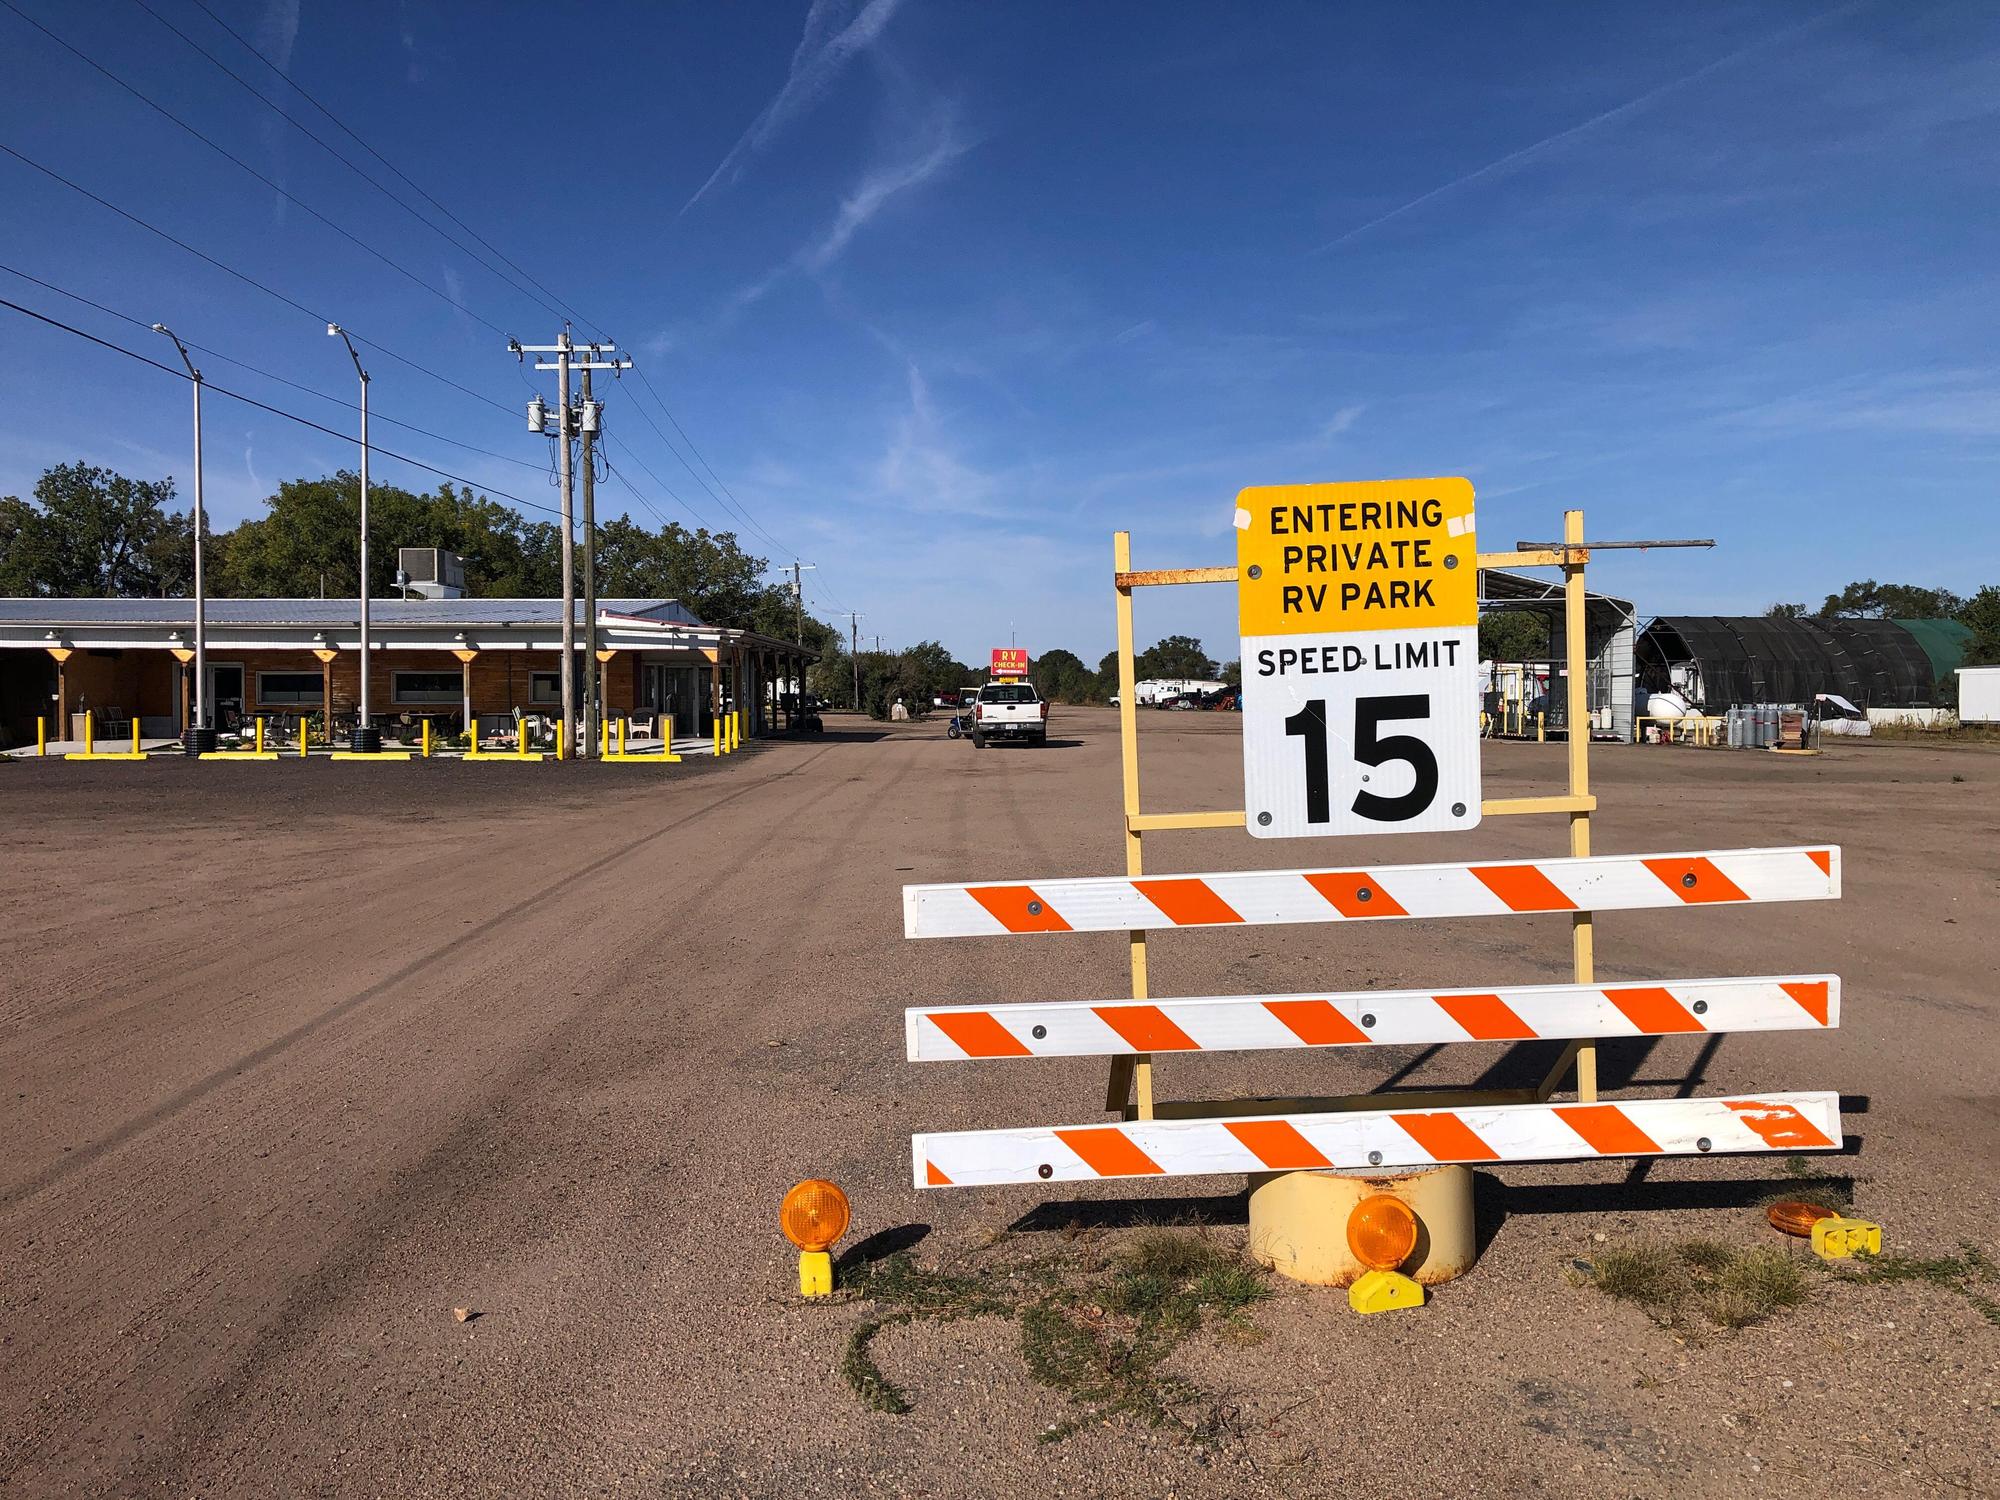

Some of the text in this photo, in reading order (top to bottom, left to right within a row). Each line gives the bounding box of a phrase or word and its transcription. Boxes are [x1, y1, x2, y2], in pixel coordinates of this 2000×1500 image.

[1271, 499, 1443, 535] ENTERING
[1284, 540, 1433, 574] PRIVATE
[1283, 579, 1436, 614] RV PARK
[993, 661, 1025, 669] CHECK-IN
[1258, 640, 1461, 676] SPEED LIMIT
[1285, 694, 1439, 823] 15
